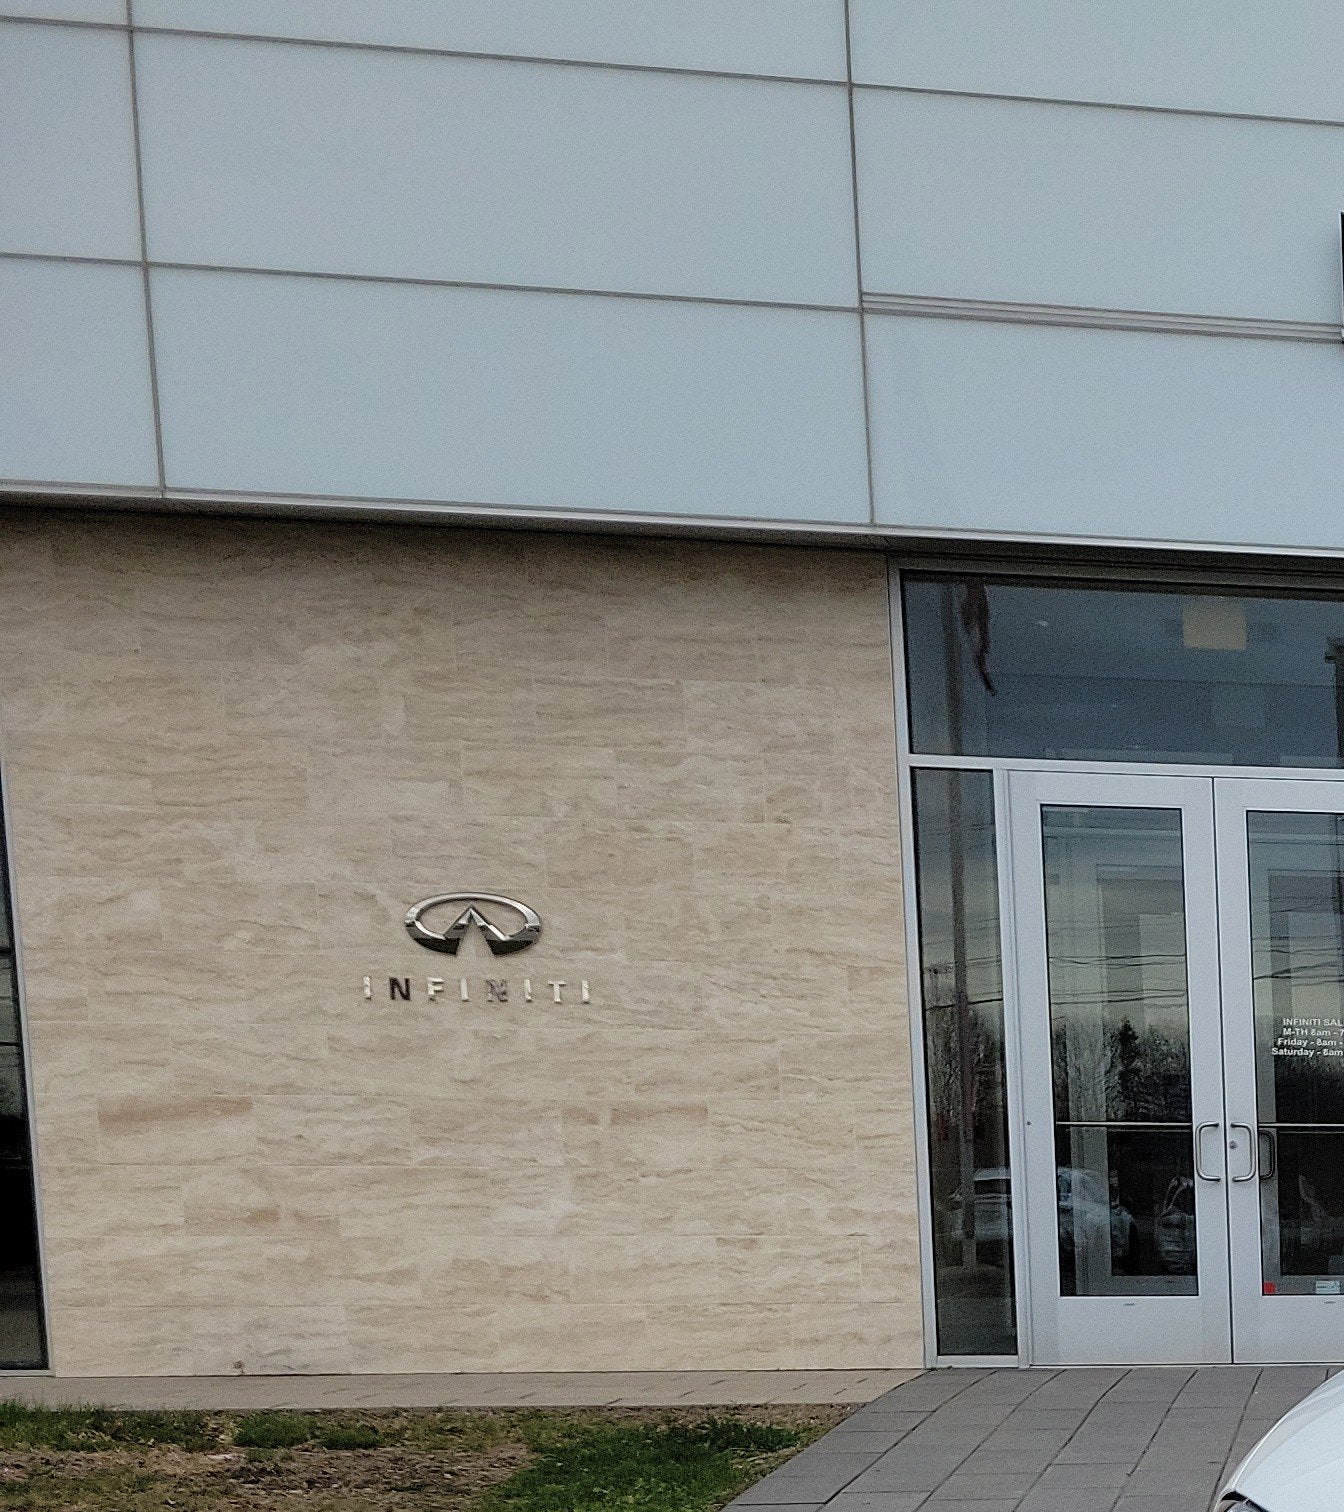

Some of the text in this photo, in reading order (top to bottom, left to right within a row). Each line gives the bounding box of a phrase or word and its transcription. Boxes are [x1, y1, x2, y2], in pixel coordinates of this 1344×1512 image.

[363, 975, 592, 1003] INFINITI
[1283, 1018, 1320, 1026] INFINITI
[1277, 1037, 1308, 1047] Friday
[1271, 1047, 1315, 1057] Saturday
